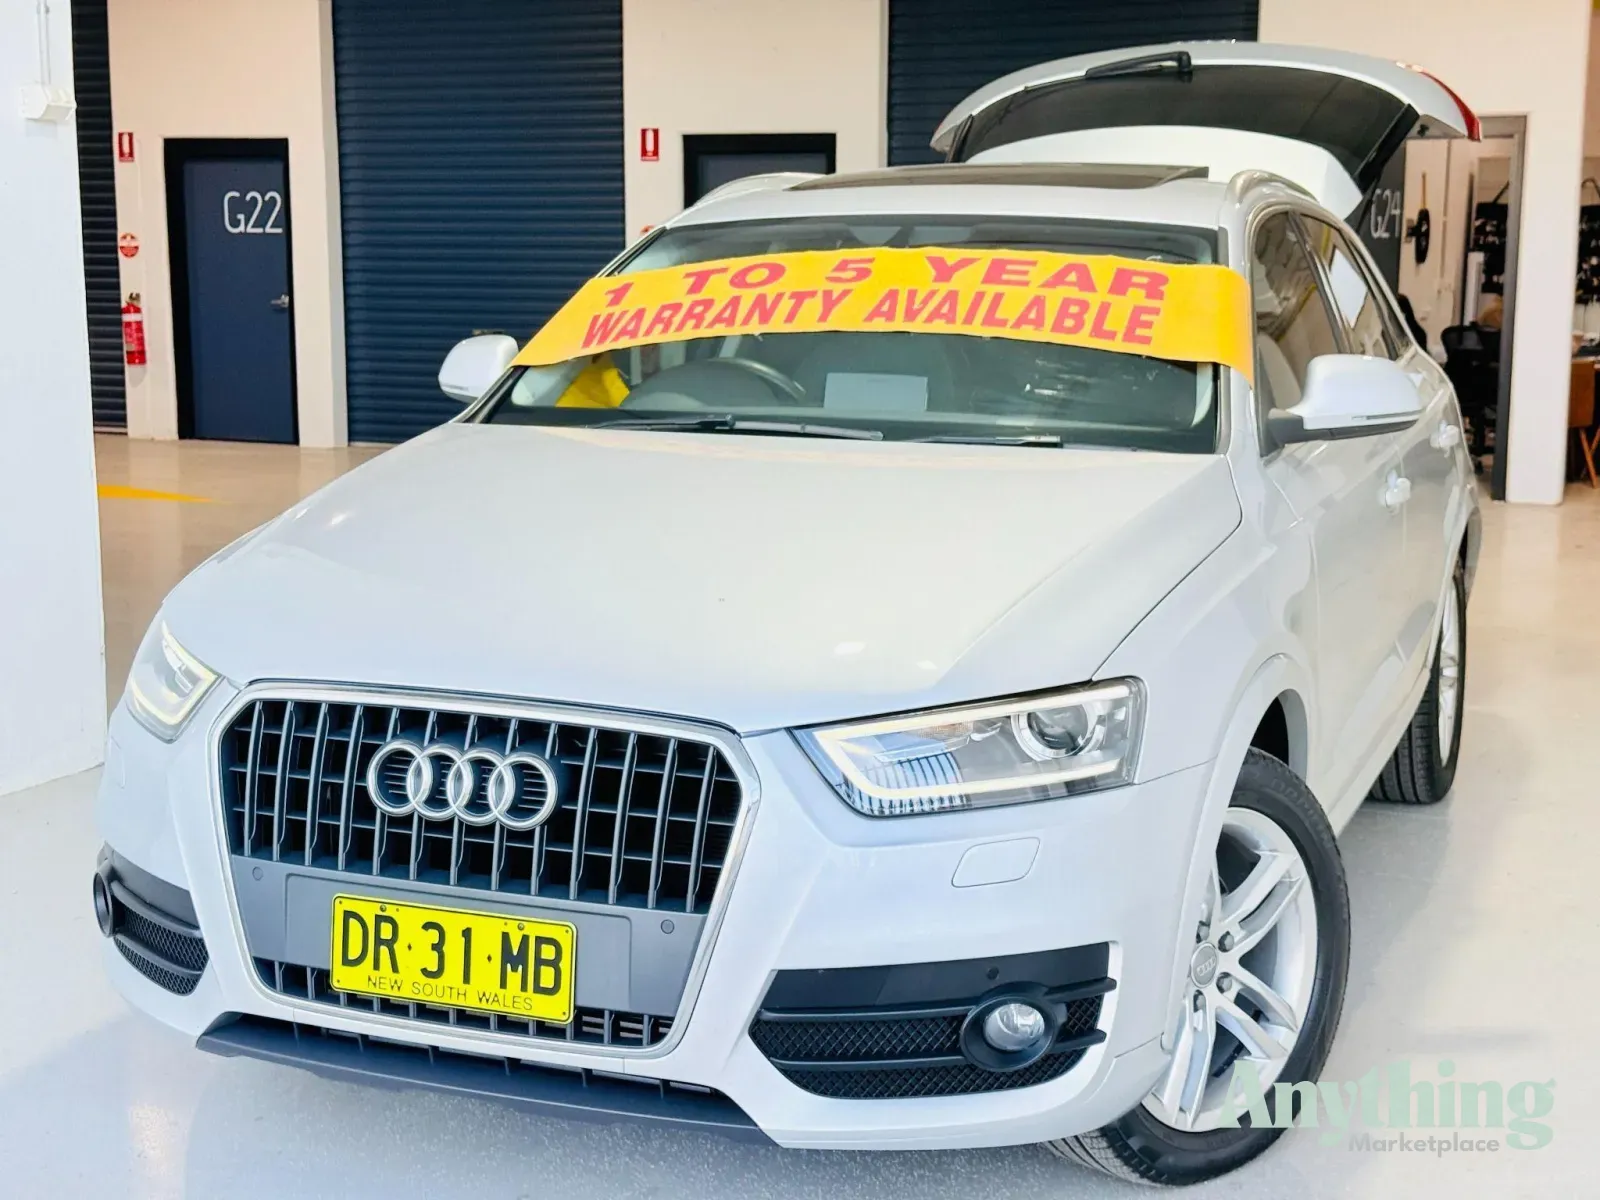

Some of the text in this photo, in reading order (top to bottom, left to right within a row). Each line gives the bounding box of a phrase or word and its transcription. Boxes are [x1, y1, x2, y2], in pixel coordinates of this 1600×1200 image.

[223, 191, 284, 234] G22
[1370, 188, 1401, 238] G24
[604, 255, 1170, 308] 1 TO 5 YEAR
[580, 288, 1161, 349] WARRANTY AVAILABLE
[367, 974, 533, 1011] NEW SOUTH WALES
